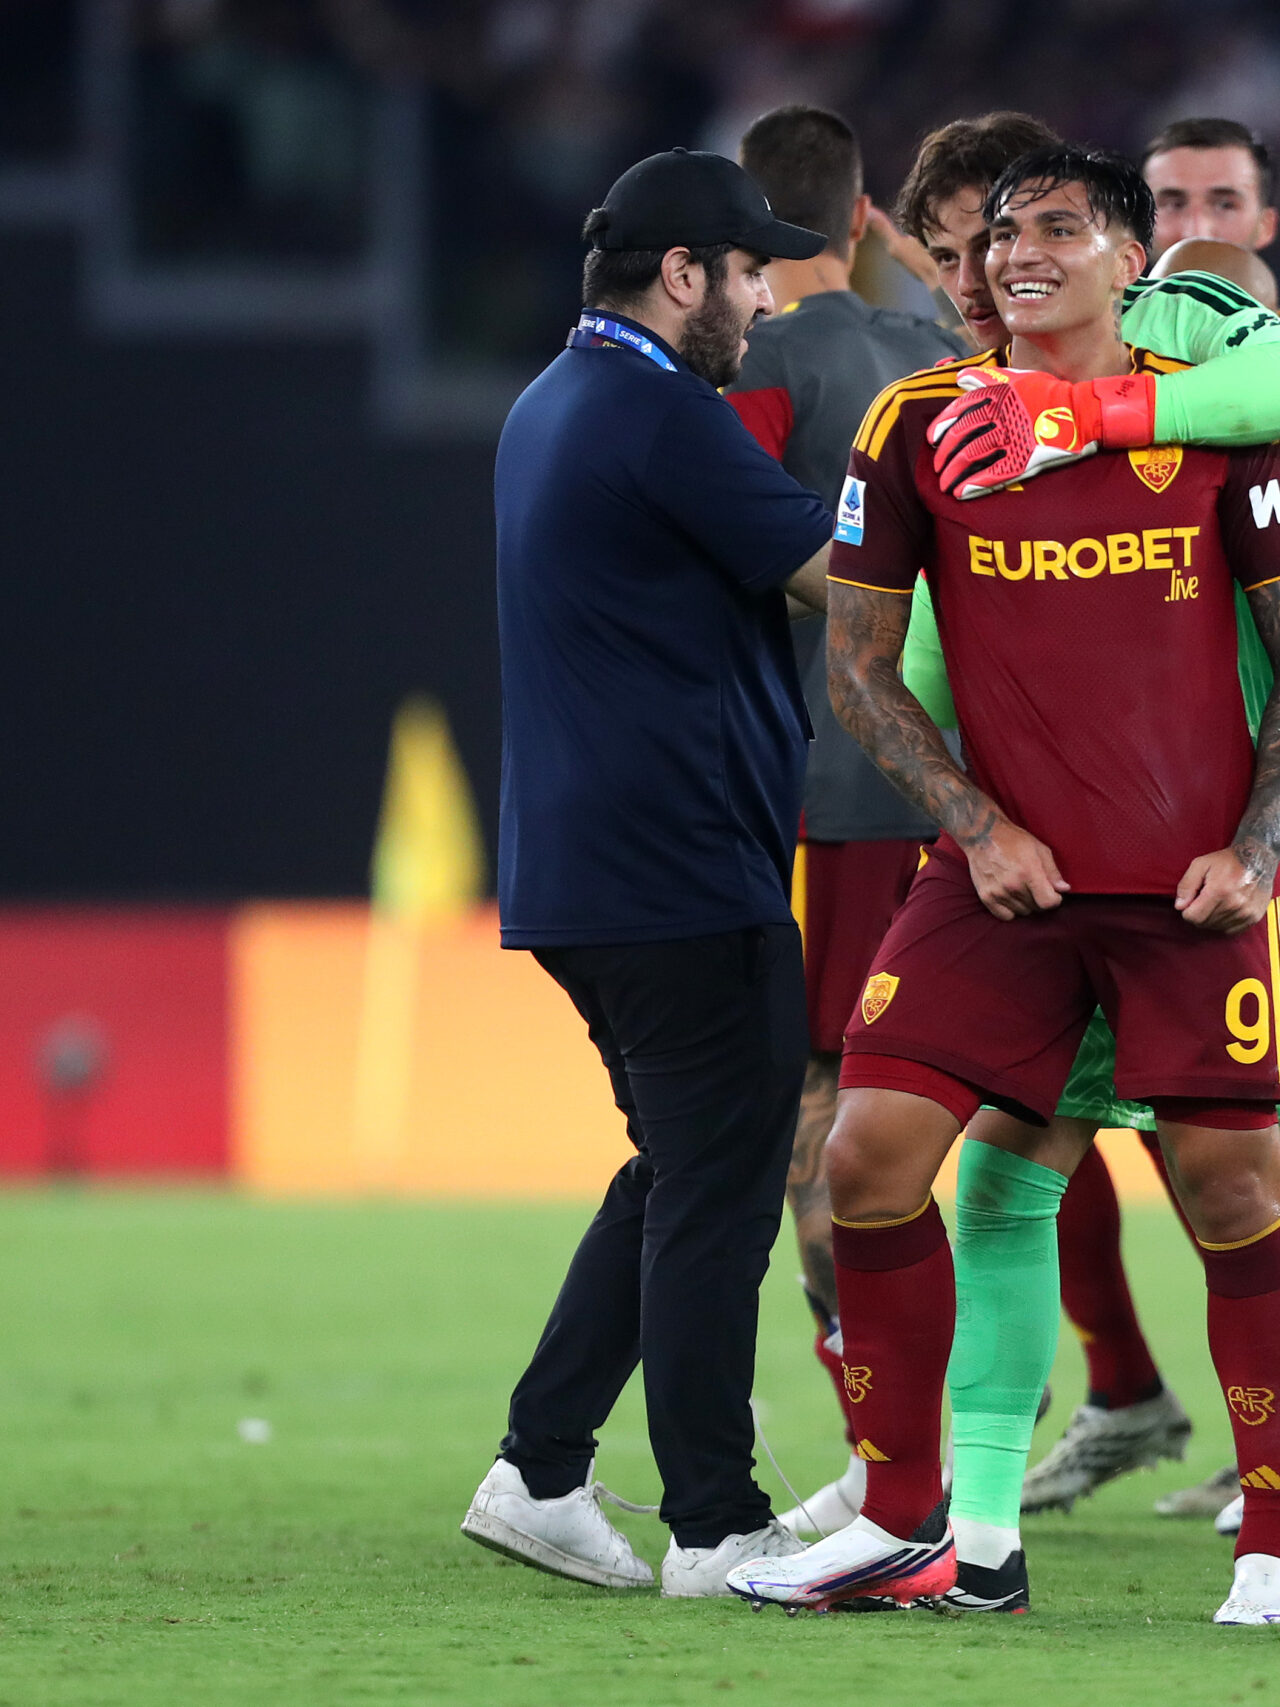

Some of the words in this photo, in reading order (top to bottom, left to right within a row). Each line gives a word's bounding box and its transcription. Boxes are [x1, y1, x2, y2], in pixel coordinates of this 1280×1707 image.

[620, 330, 642, 346] SERIE
[969, 525, 1200, 581] EUROBET
[1164, 569, 1199, 602] .live
[1225, 977, 1270, 1065] 9
